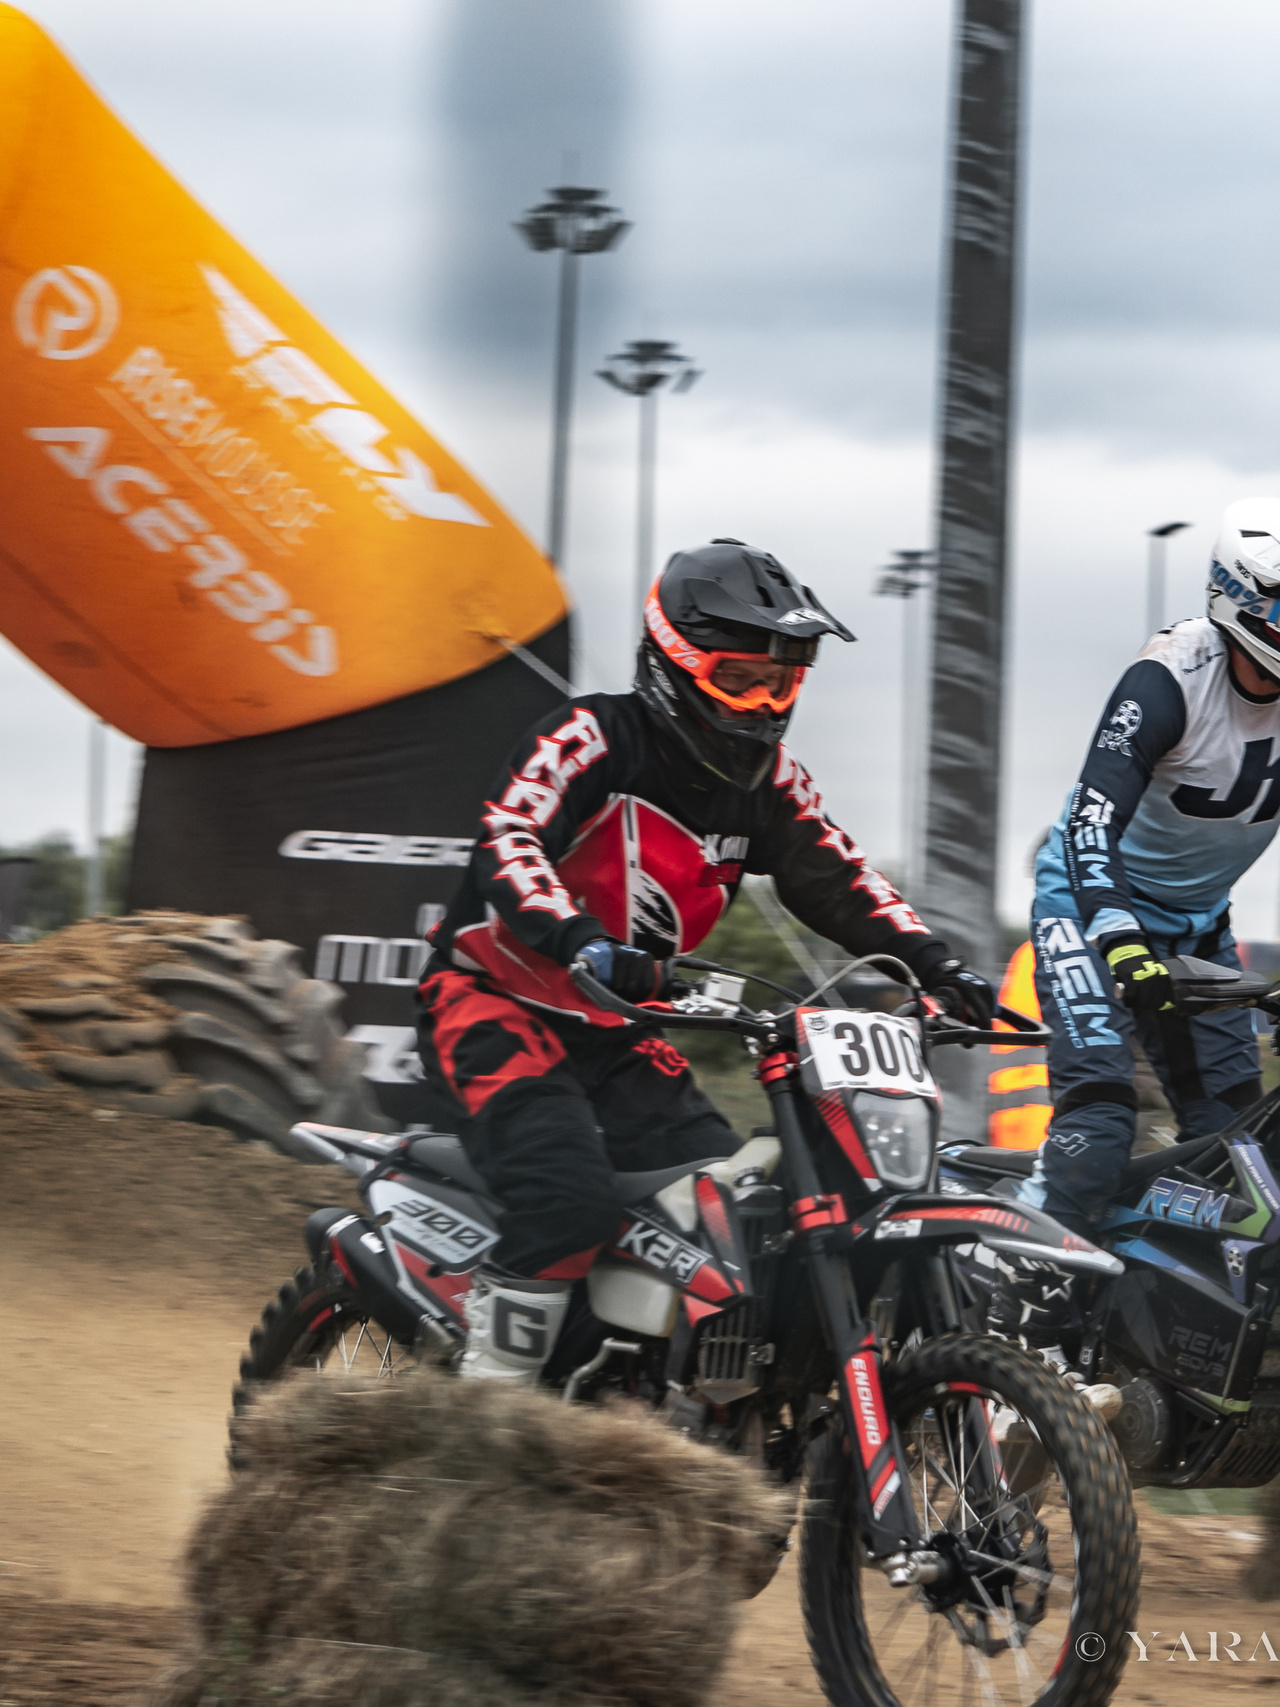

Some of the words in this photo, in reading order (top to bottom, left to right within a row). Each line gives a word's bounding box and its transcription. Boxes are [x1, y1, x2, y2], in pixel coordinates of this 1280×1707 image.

[834, 1021, 925, 1084] 300
[391, 1198, 498, 1252] 300
[1134, 1176, 1231, 1230] REM
[617, 1220, 712, 1284] K2R
[1168, 1325, 1234, 1361] REM
[851, 1357, 882, 1447] ENDURO
